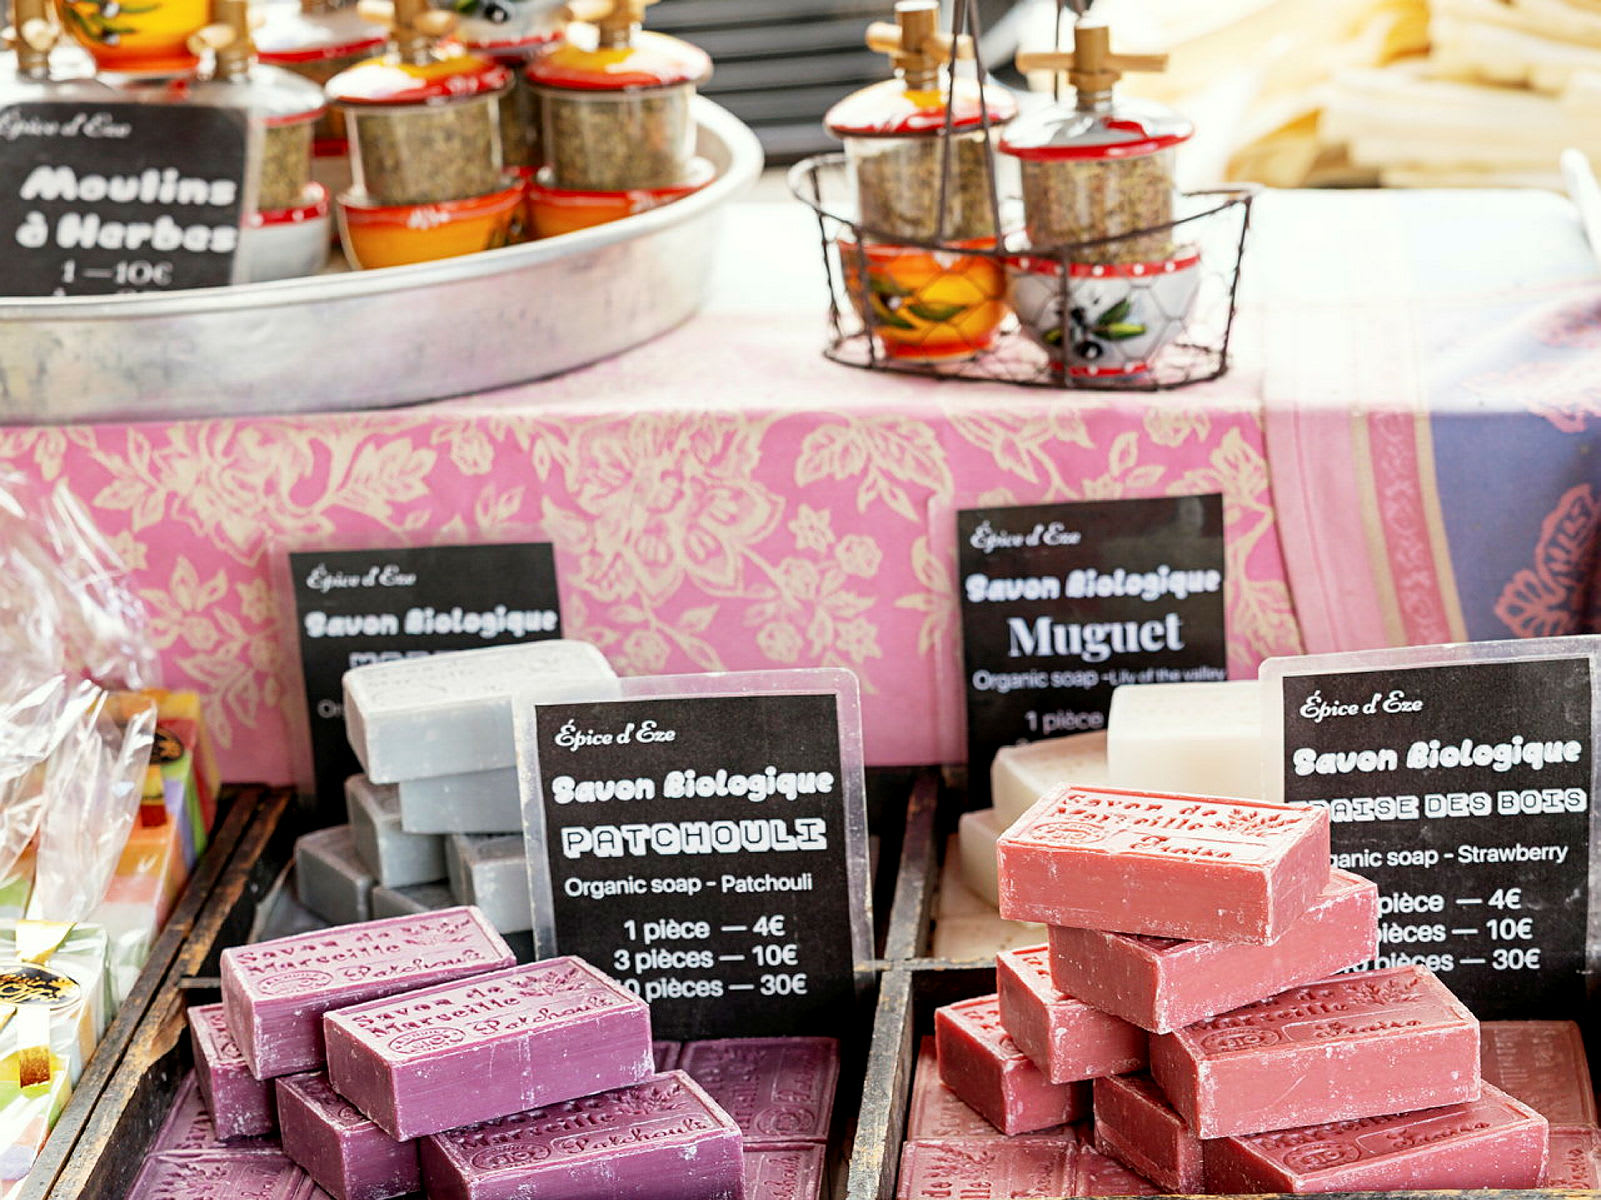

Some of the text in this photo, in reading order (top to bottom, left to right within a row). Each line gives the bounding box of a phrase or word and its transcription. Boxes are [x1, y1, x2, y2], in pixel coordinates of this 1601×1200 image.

[20, 165, 237, 206] Moulins
[15, 210, 238, 253] à Herbes
[114, 259, 173, 286] 10€
[970, 519, 1024, 554] Épice
[306, 563, 360, 594] Épice
[965, 564, 1221, 603] Savon Biologique
[304, 604, 558, 639] Savon Biologique
[1008, 612, 1185, 663] Muguet
[972, 669, 1049, 694] Organic
[1050, 670, 1098, 690] soap
[1025, 709, 1104, 734] 1 pièce
[1300, 690, 1359, 722] Épice
[555, 719, 613, 751] Épice
[1293, 735, 1582, 776] Savon Biologique
[551, 766, 834, 804] Savon Biologique
[1425, 792, 1492, 818] DES
[1496, 787, 1588, 815] BOIS
[561, 818, 827, 859] PATCHOULI
[1386, 850, 1439, 869] soap
[1457, 842, 1569, 865] Strawberry
[564, 872, 813, 899] Organic soap Patchouli
[1487, 887, 1522, 911] 4€
[624, 915, 786, 944] 1 pièce 4€
[1486, 917, 1533, 940] 10€
[613, 944, 799, 974] 3 pièces 10€
[1492, 948, 1541, 970] 30€
[645, 976, 723, 1003] pièces
[760, 974, 808, 996] 30€
[352, 997, 453, 1028] Savon
[367, 996, 521, 1038] Marseille
